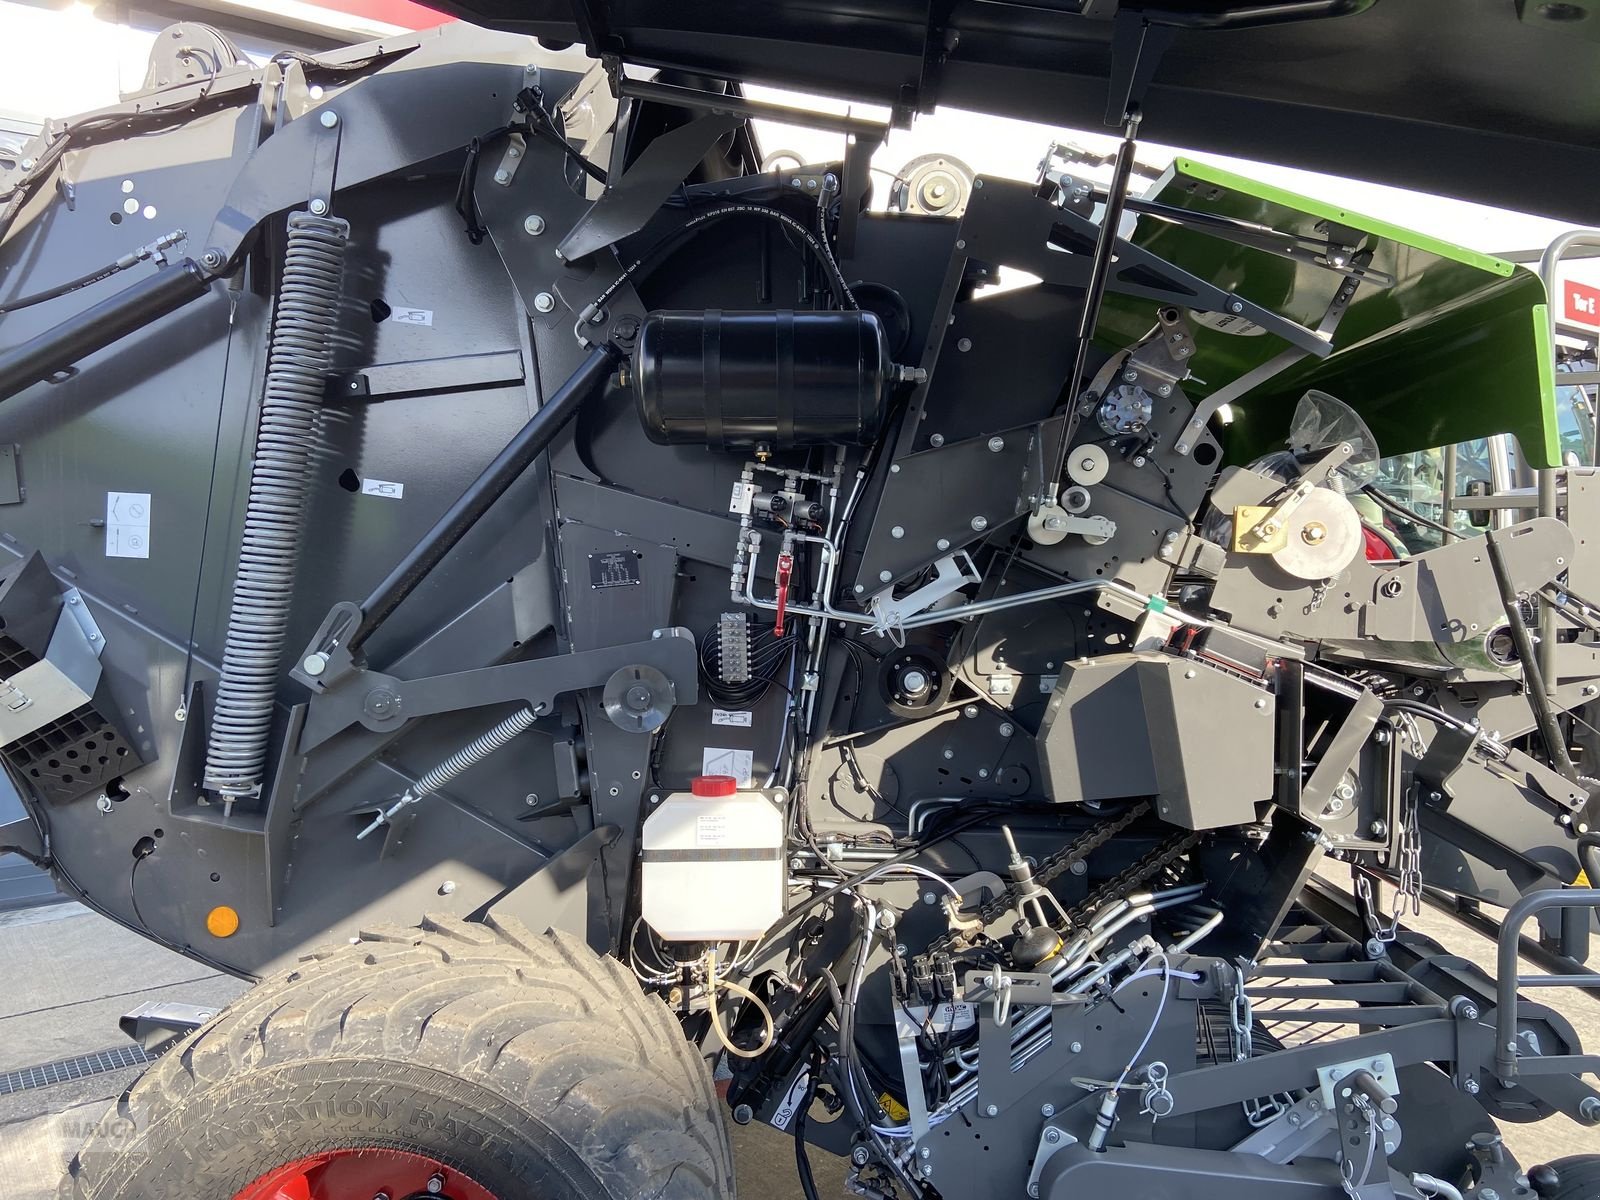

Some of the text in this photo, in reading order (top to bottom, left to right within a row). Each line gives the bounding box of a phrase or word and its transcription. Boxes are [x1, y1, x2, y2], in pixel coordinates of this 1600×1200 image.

[1572, 292, 1596, 315] Tor E
[196, 1100, 390, 1164] FLOTATION
